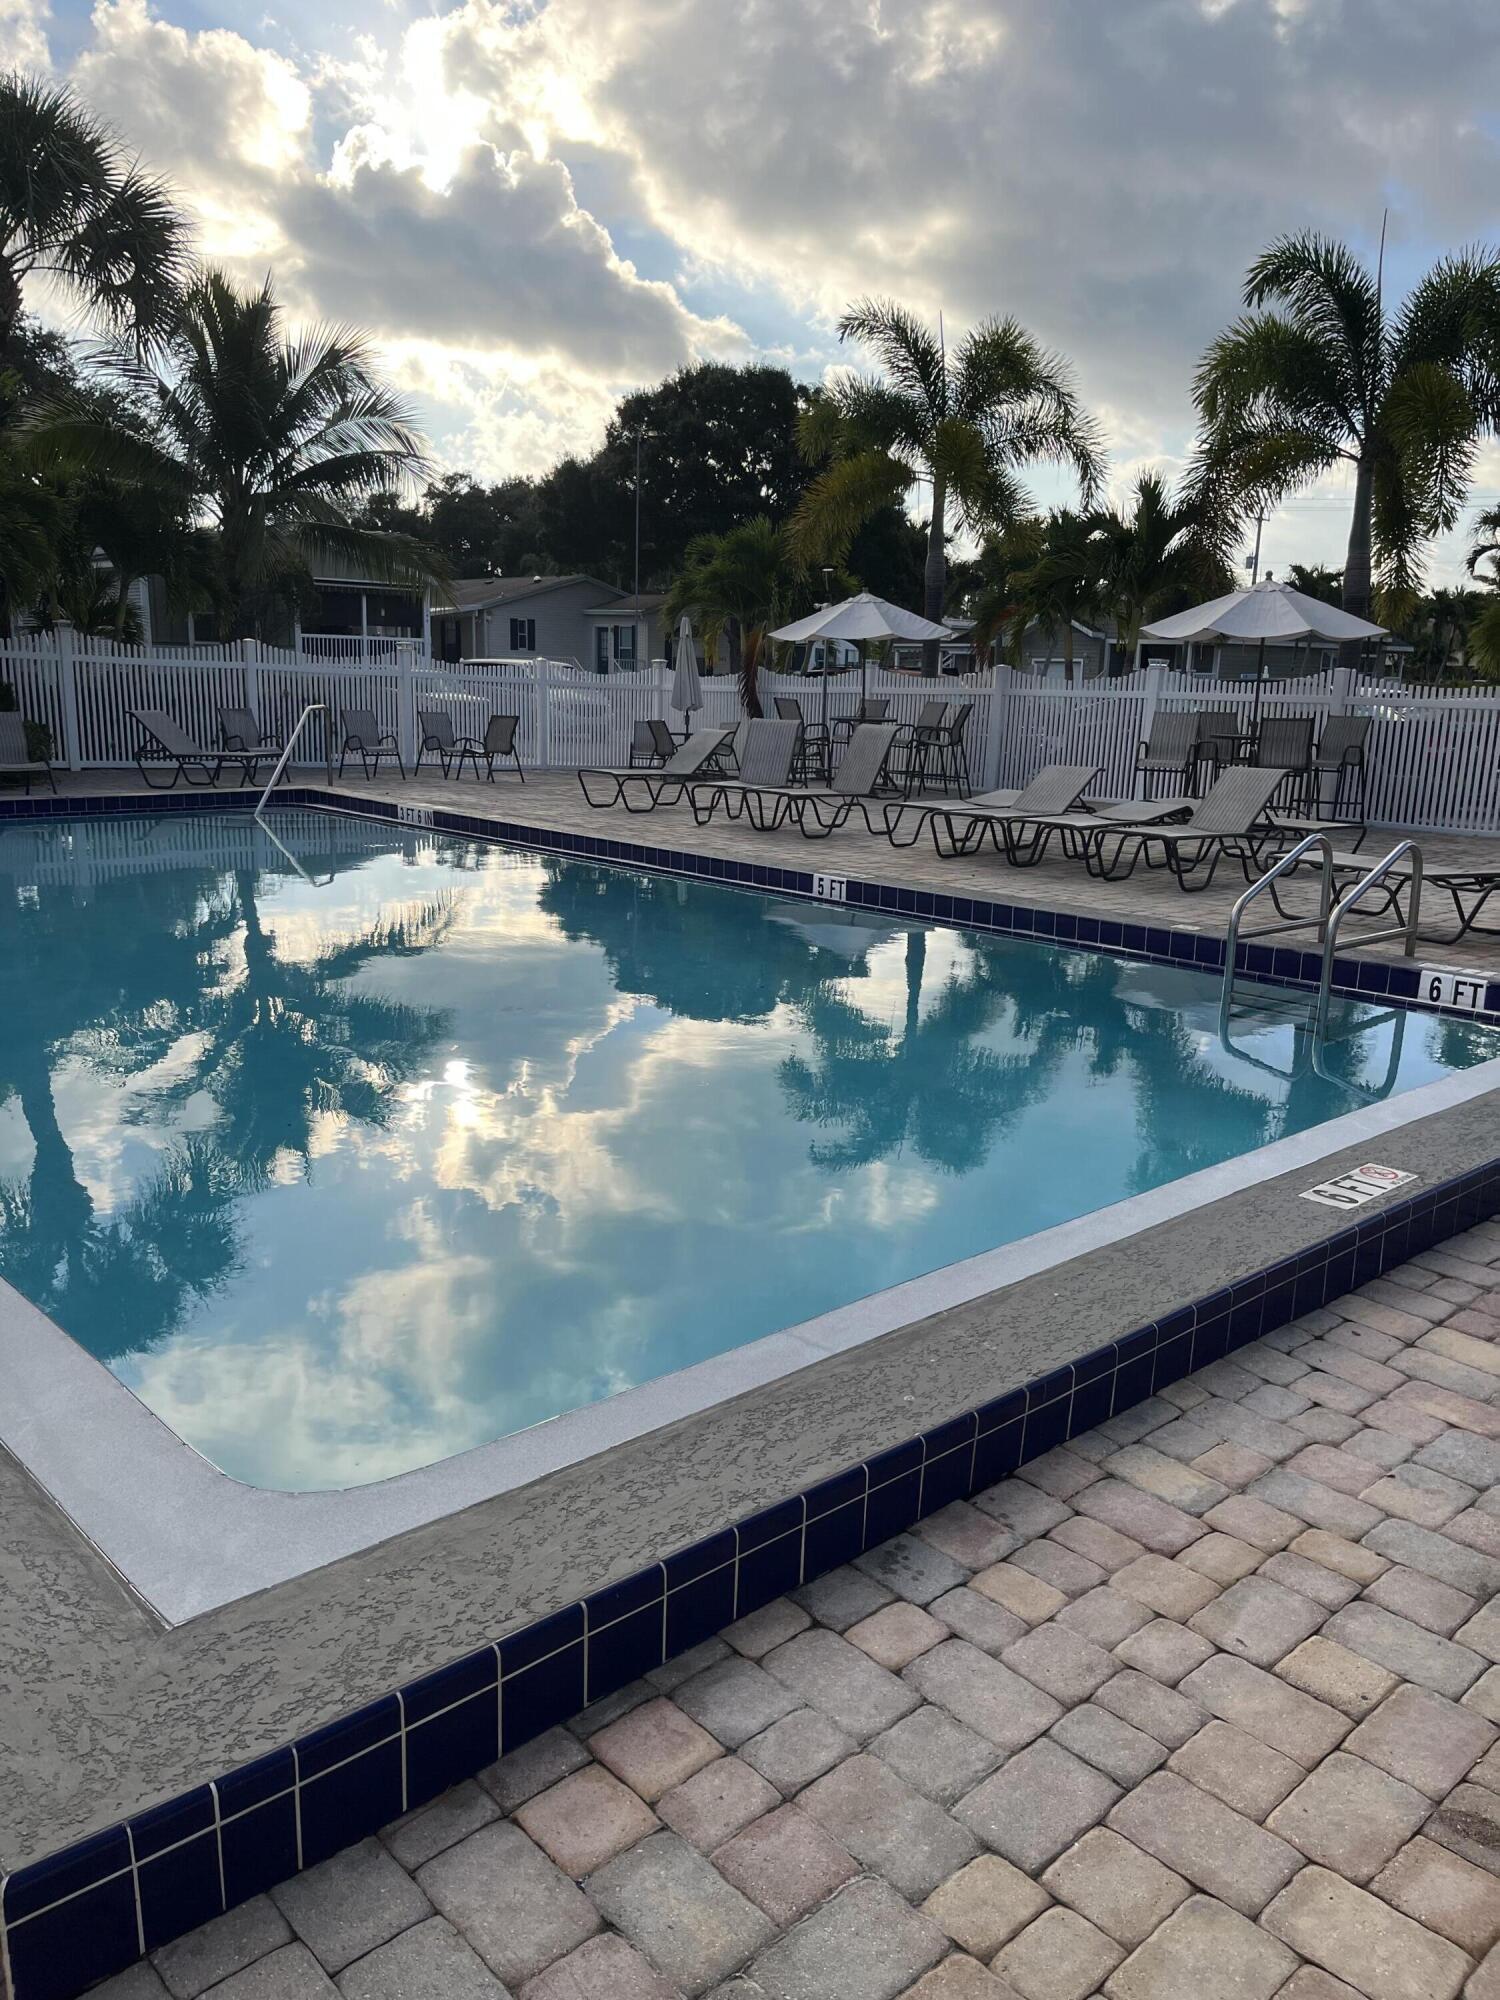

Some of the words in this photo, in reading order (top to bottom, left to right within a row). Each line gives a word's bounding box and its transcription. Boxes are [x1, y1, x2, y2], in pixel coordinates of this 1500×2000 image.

[400, 806, 405, 821] 3
[406, 807, 415, 823] FT
[417, 809, 422, 825] 6
[424, 810, 433, 827] IN
[818, 877, 825, 896] 5
[829, 879, 845, 900] FT
[1429, 976, 1442, 1002] 6
[1452, 980, 1484, 1009] FT
[1311, 1189, 1359, 1204] 6
[1328, 1174, 1388, 1197] FT
